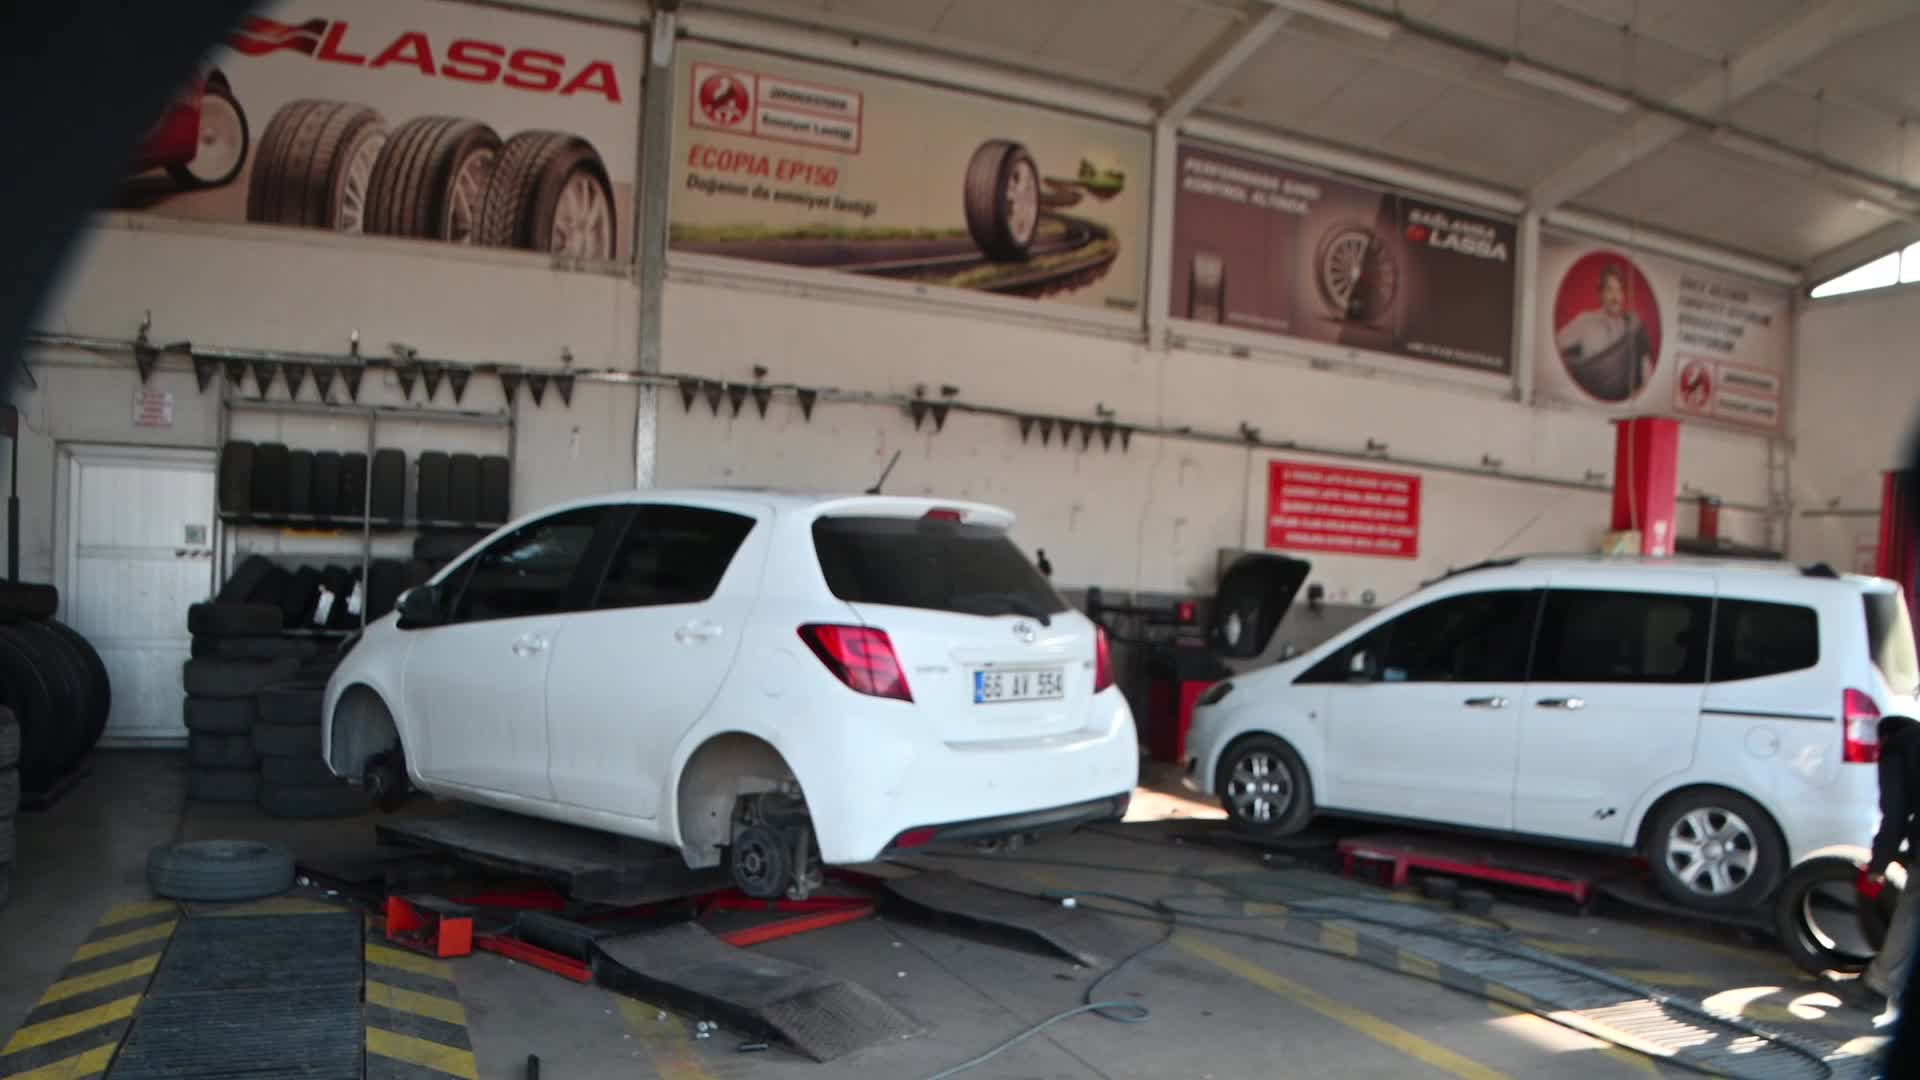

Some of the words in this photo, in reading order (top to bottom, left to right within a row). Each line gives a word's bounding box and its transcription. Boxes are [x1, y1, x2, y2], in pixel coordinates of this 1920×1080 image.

[318, 20, 622, 104] LASSA
[688, 145, 769, 177] ECOPIA
[776, 159, 839, 187] EP150
